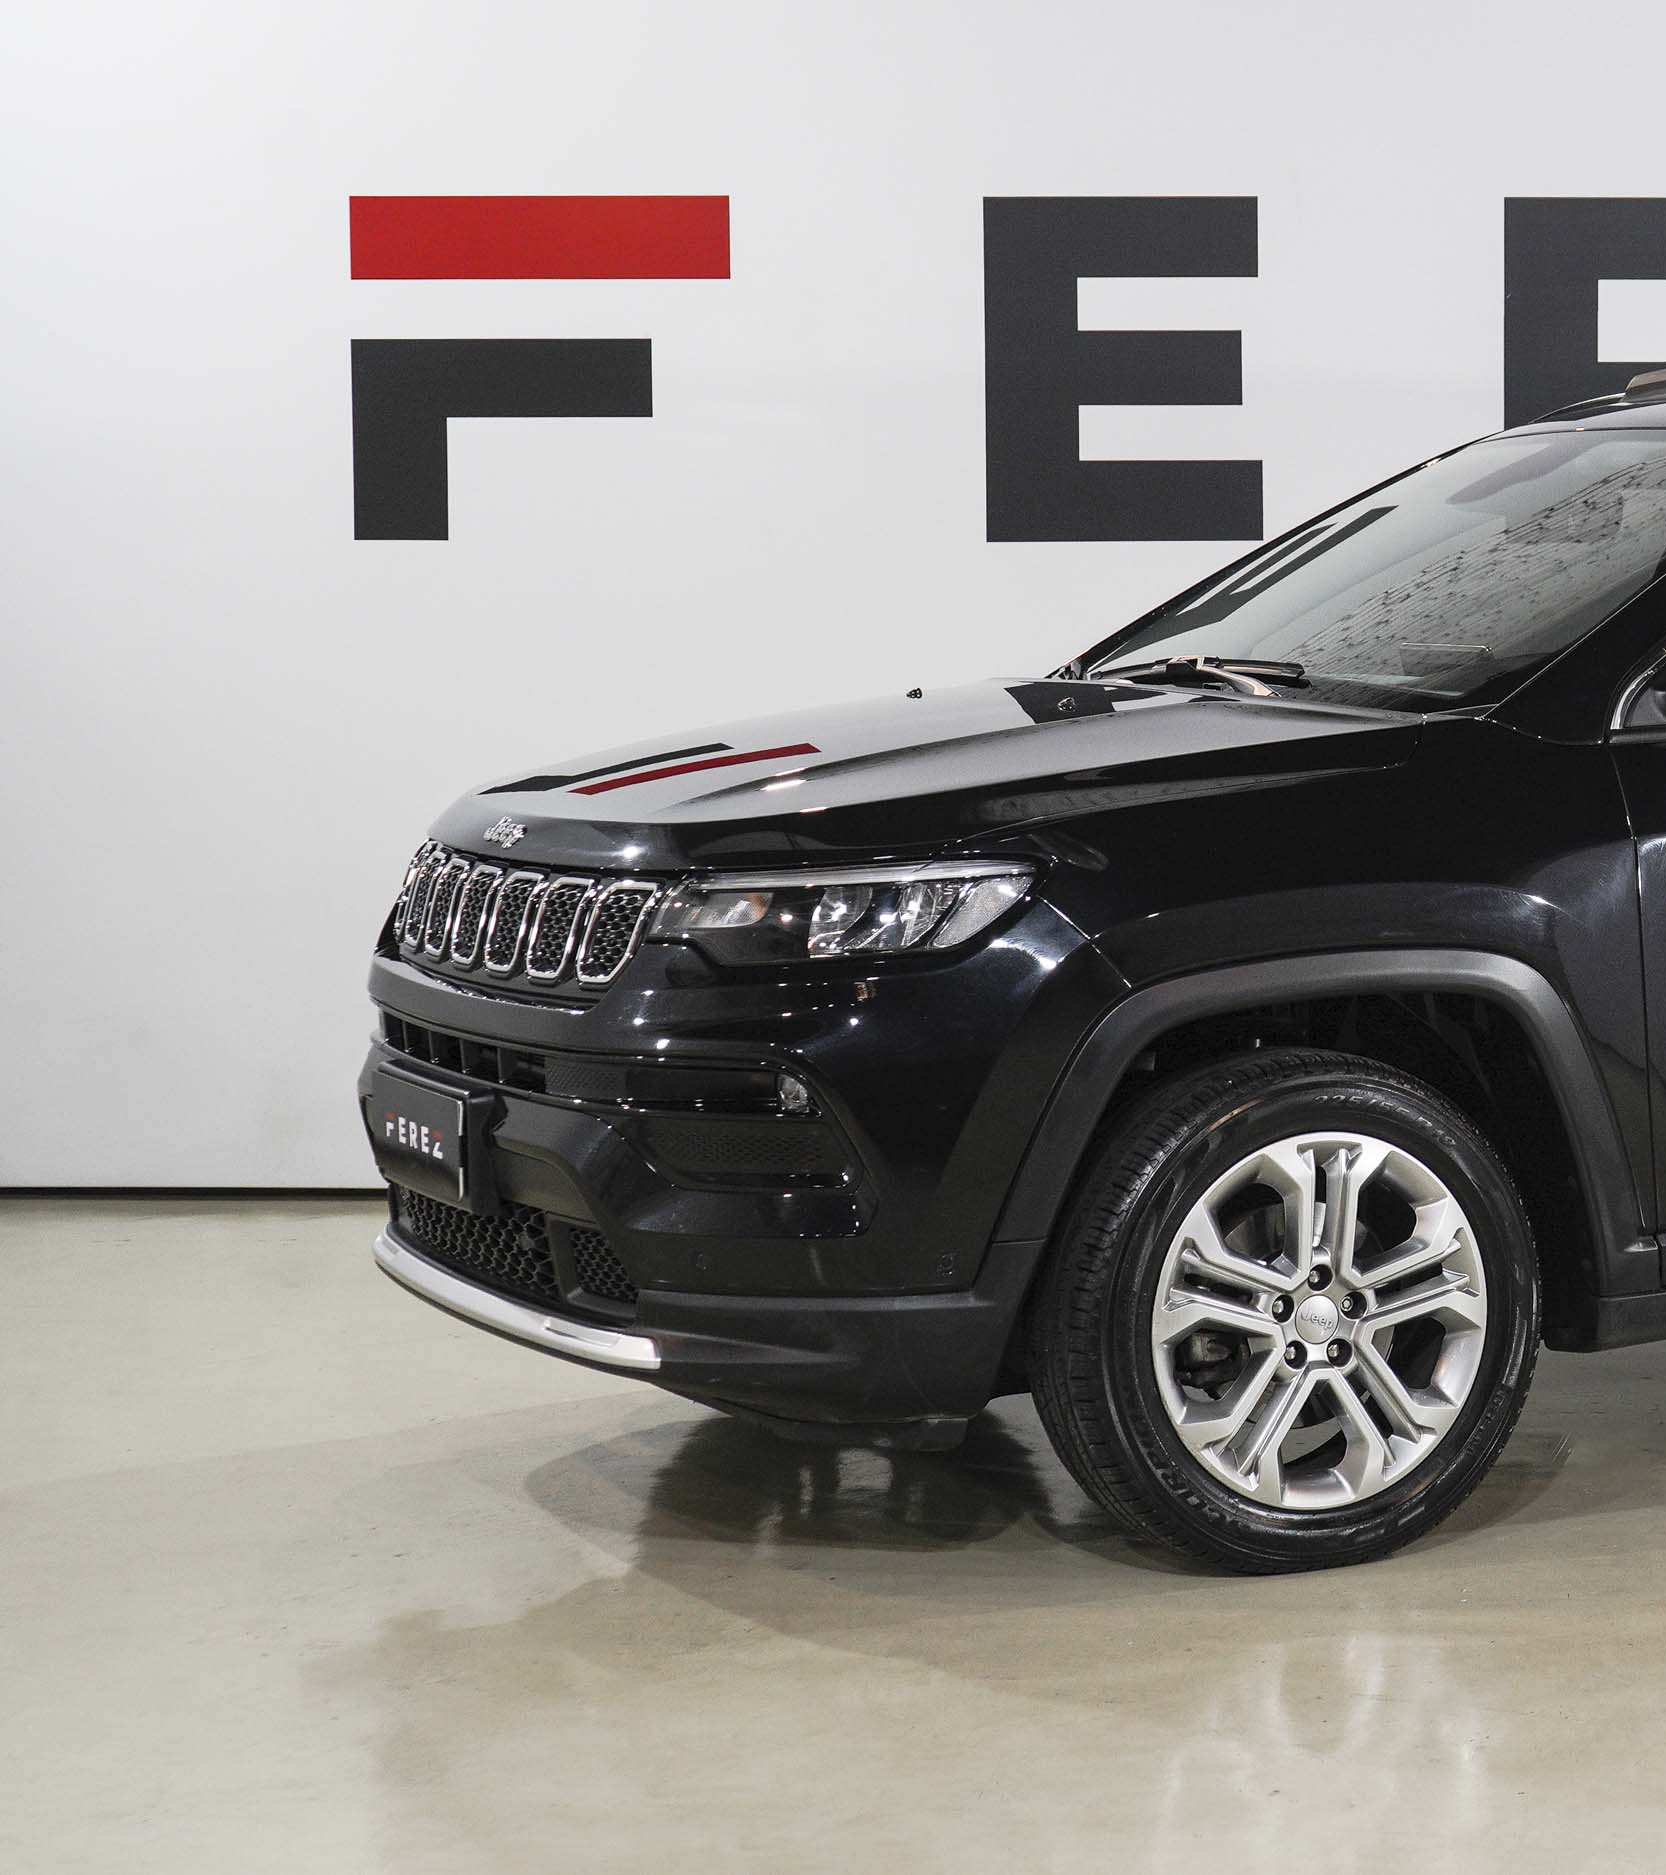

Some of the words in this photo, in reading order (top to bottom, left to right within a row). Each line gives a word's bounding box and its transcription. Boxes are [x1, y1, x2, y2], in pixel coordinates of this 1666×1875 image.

[482, 816, 527, 848] Jeep
[383, 1112, 444, 1160] FEREZ
[1300, 1306, 1334, 1331] Jeep
